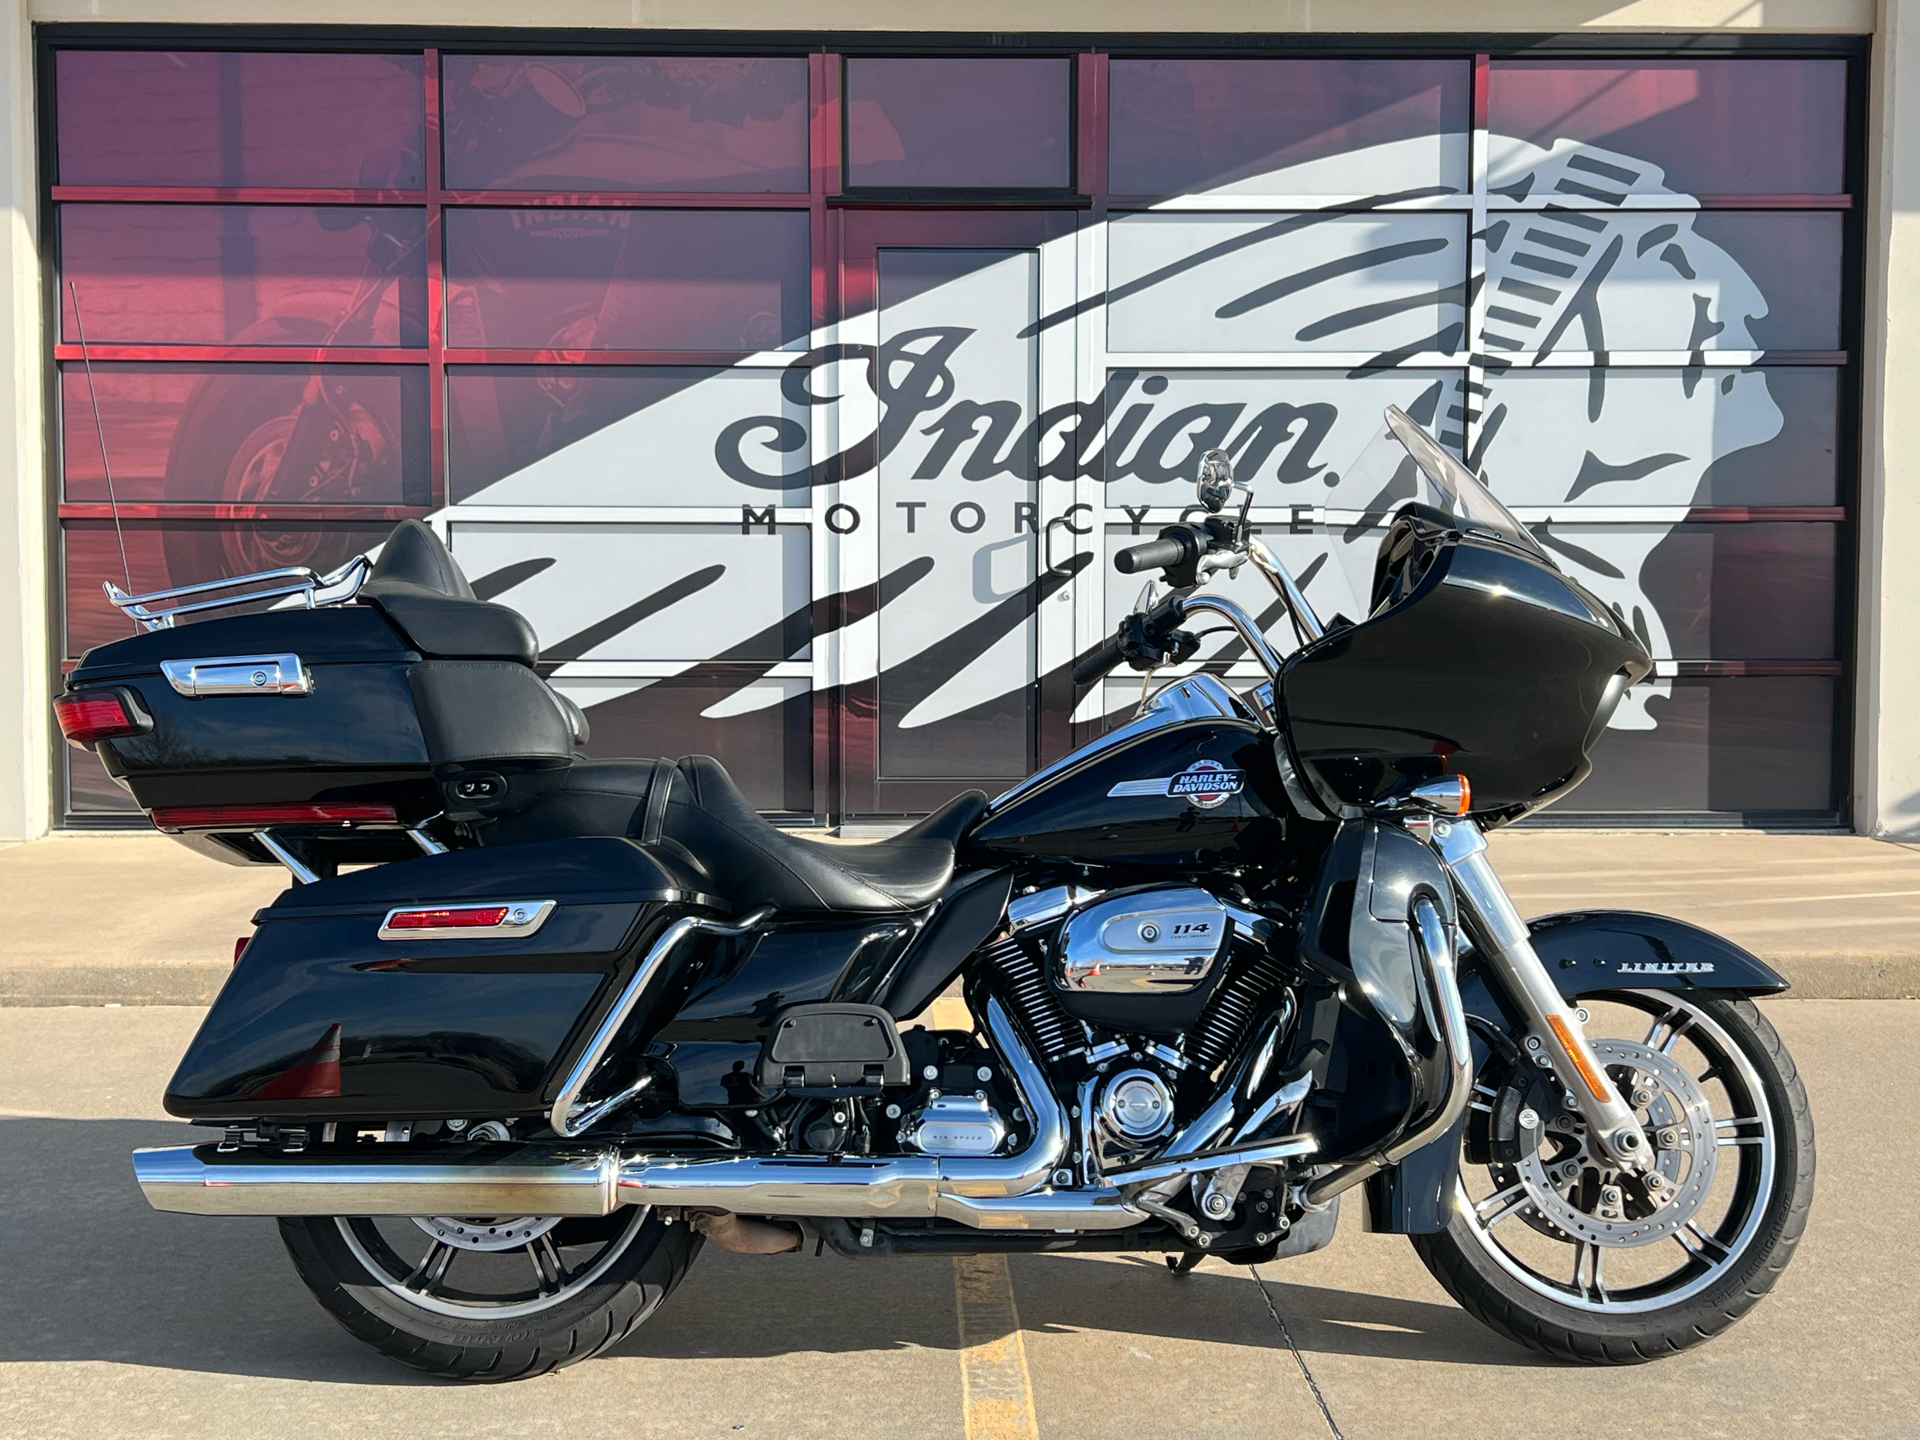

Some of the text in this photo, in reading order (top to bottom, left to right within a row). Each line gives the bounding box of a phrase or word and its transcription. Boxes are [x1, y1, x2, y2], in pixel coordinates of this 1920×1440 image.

[510, 194, 632, 230] INDIAN
[1179, 773, 1238, 784] HARLEY-
[1172, 781, 1239, 793] DAVIDSON
[1173, 923, 1210, 934] 114
[1619, 961, 1716, 973] LIMITED
